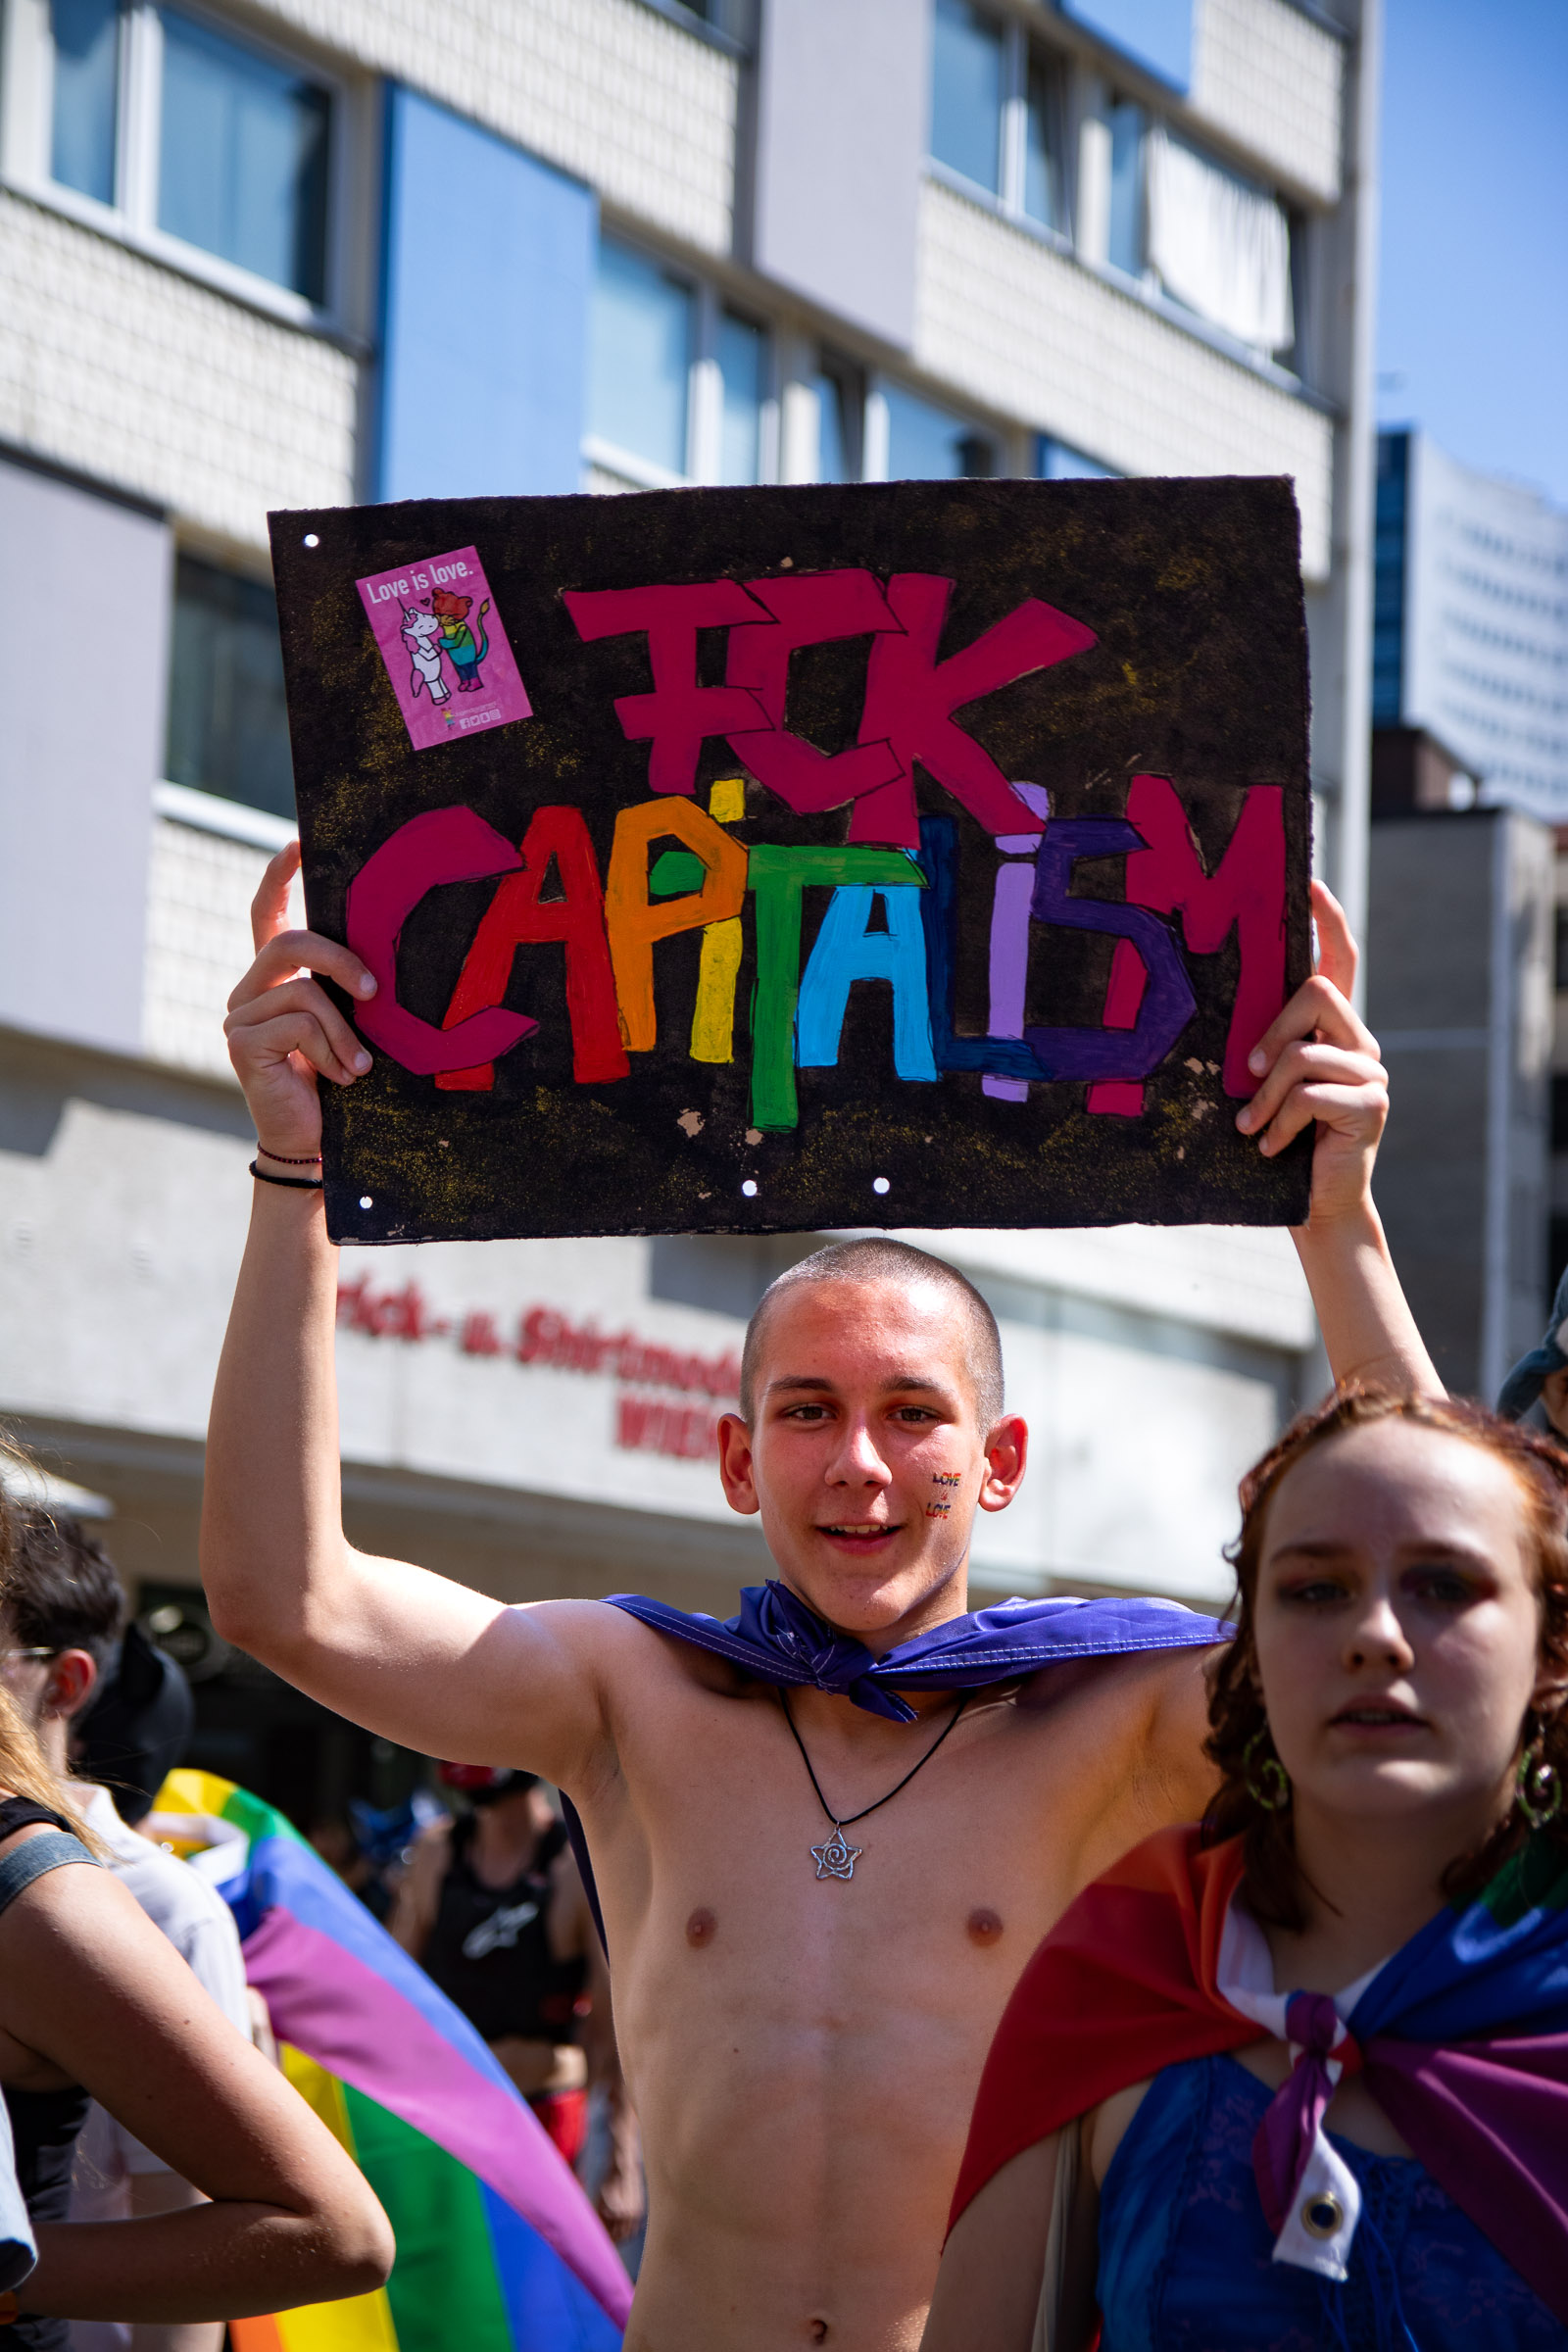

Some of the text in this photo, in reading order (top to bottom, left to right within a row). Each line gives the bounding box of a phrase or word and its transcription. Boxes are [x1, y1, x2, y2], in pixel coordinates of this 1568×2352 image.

[367, 562, 474, 604] Love is love.
[562, 568, 1098, 849] FCK
[933, 1472, 961, 1487] LOVE
[925, 1502, 951, 1519] LOVE
